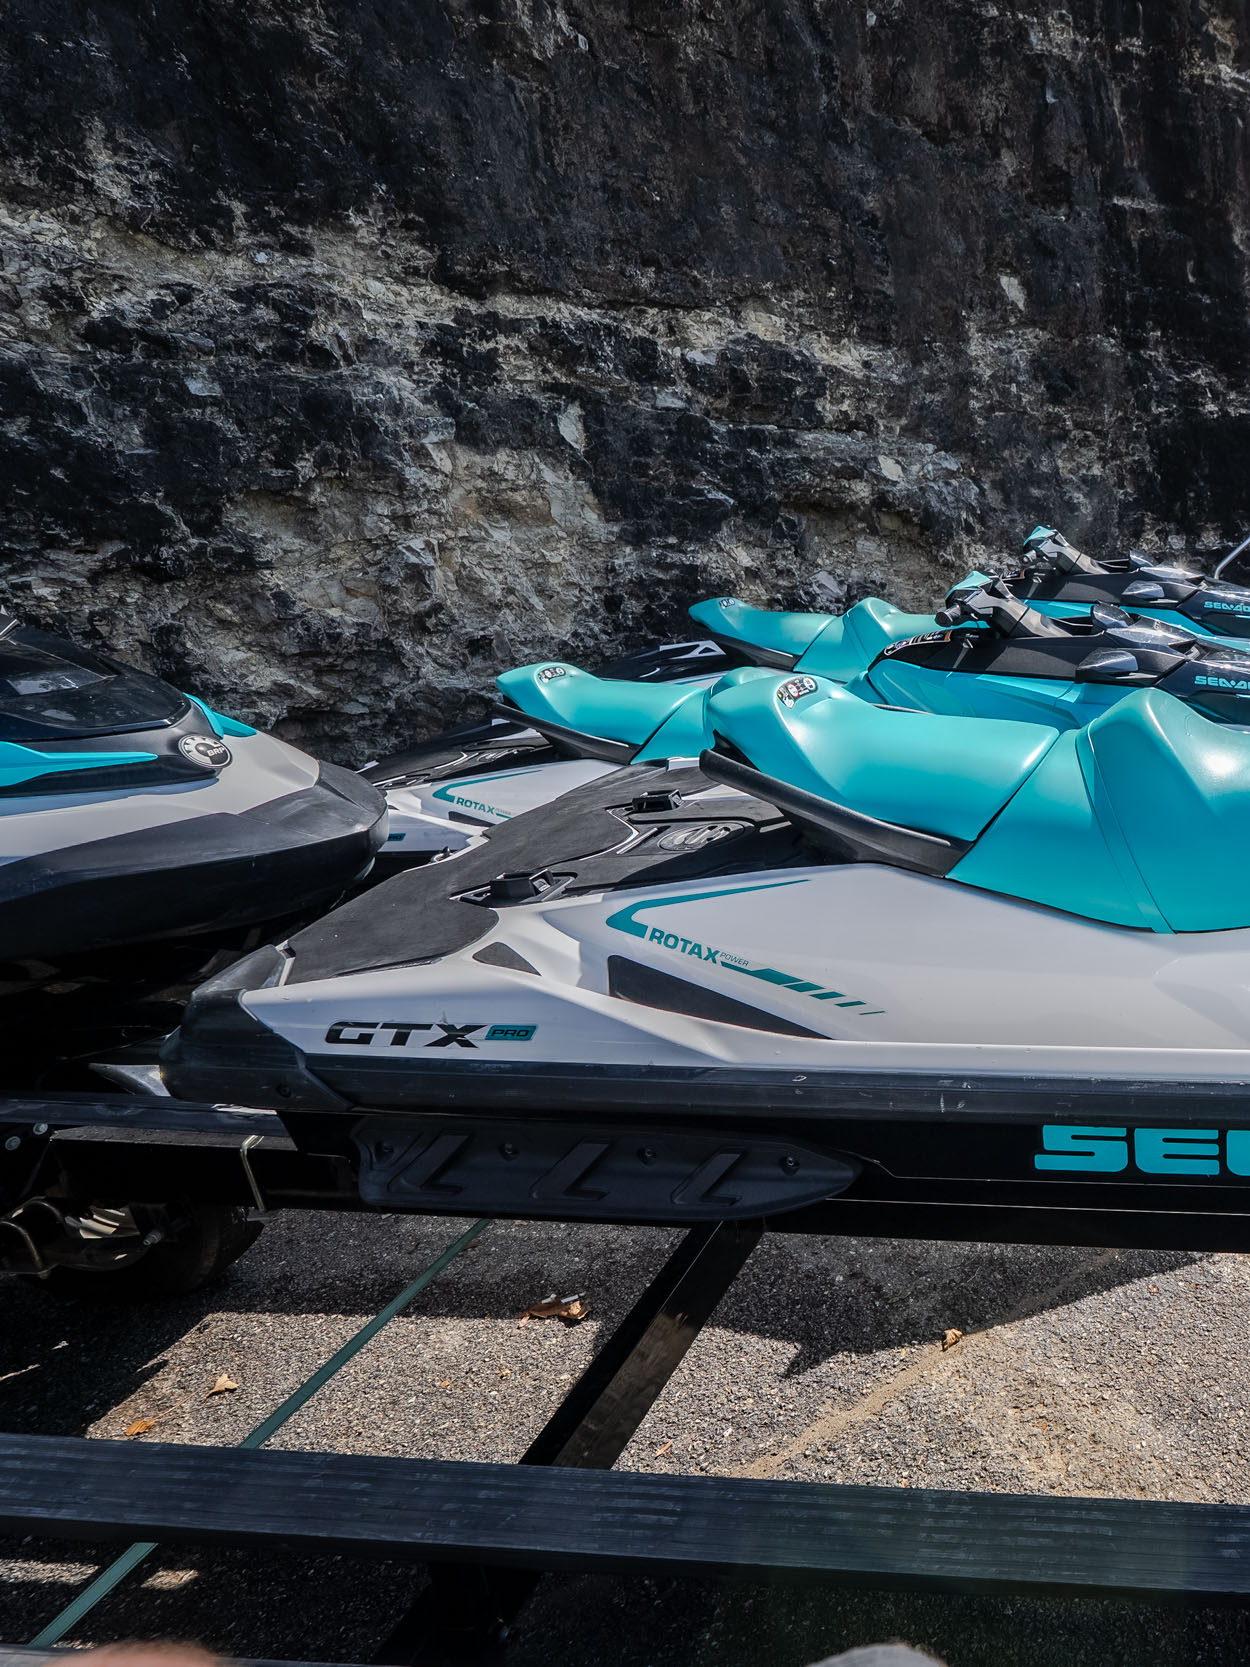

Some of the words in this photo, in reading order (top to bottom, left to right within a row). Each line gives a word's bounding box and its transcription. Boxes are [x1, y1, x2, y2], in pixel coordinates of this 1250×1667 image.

[207, 746, 225, 757] BRP
[456, 797, 495, 815] ROTAX
[649, 927, 720, 964] ROTAX
[720, 952, 749, 967] POWER
[325, 1021, 488, 1049] GTX
[491, 1028, 530, 1037] PRO
